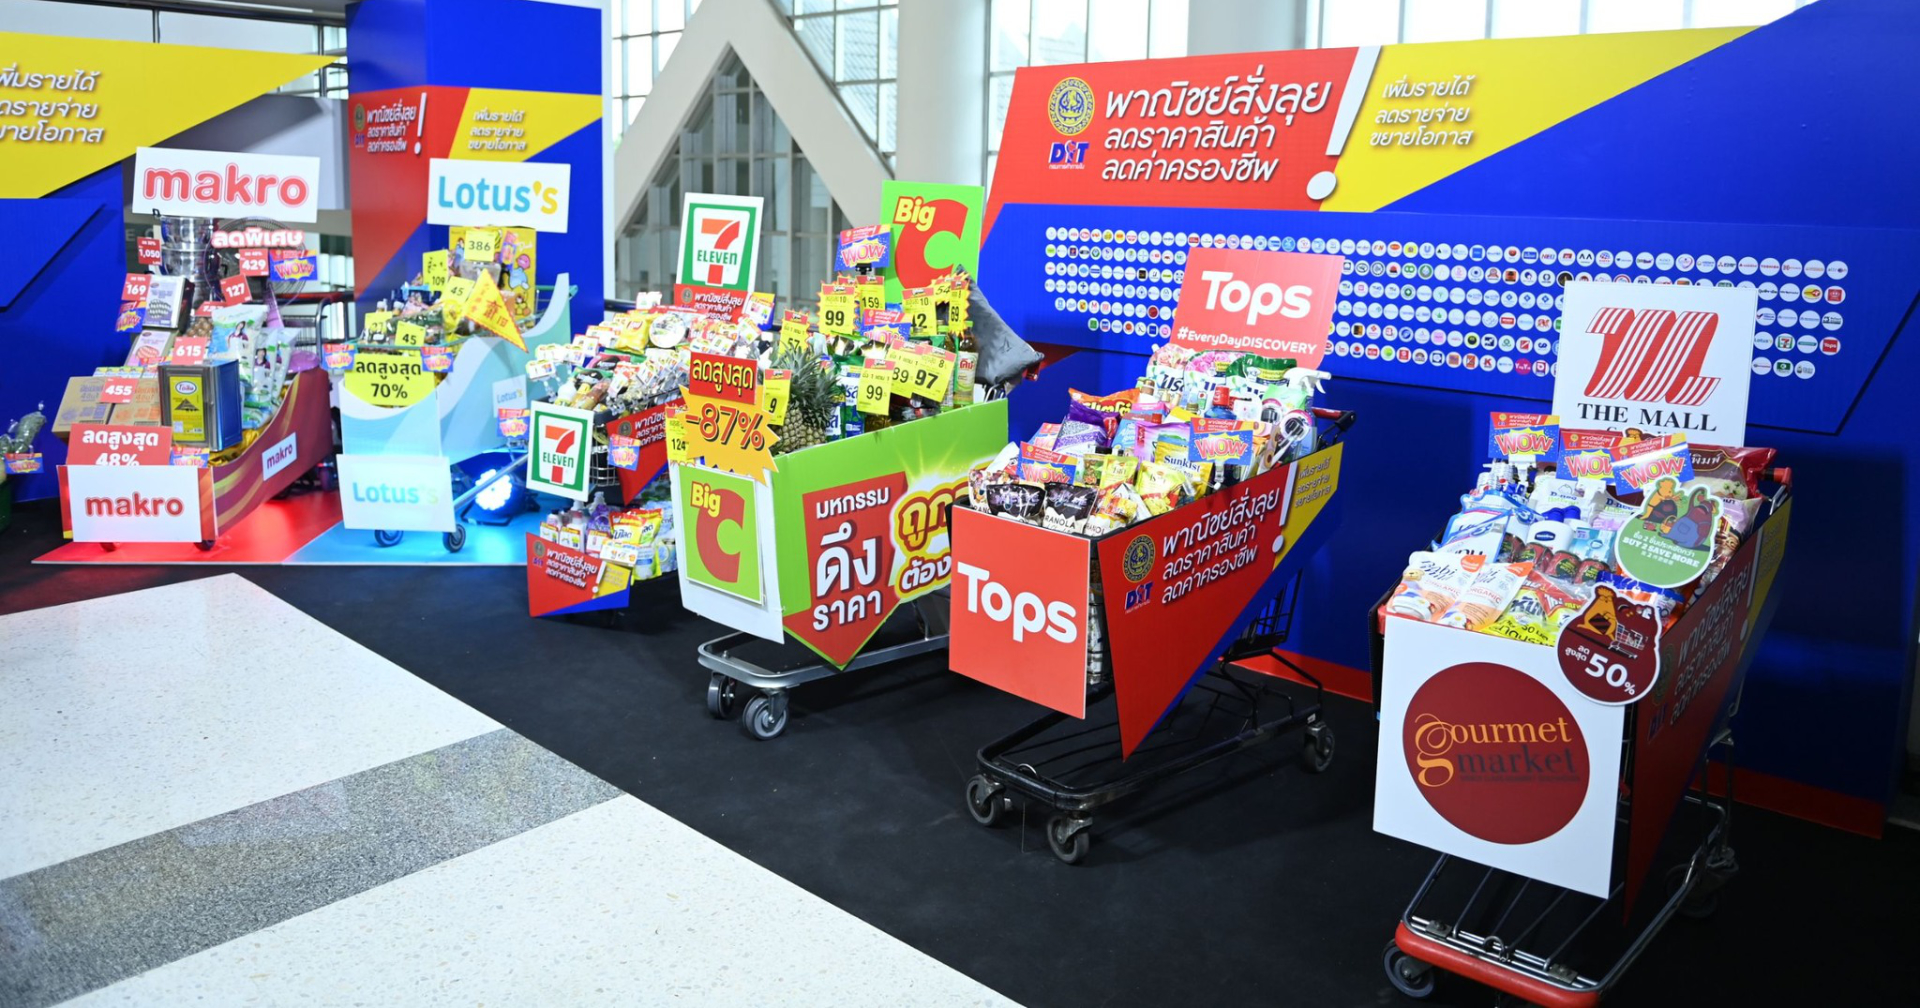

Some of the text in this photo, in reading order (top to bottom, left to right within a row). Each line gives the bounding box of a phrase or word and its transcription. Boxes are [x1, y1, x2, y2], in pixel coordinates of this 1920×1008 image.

[1106, 64, 1331, 126] พาณิชย์สั่งลุย
[1382, 73, 1477, 98] เพิ่มรายได้
[473, 107, 525, 123] เพิ่มรายได้
[1374, 103, 1470, 125] ลดรายจ่าย
[469, 124, 523, 138] ลดรายจ่าย
[1104, 115, 1275, 150] ลดราคาสินค้า
[1369, 126, 1474, 148] ขยายโอกาส
[467, 137, 527, 151] ขยายโอกาส
[1101, 151, 1279, 182] ลดค่าครองชีพ
[143, 163, 309, 207] makro
[438, 175, 558, 214] Lotus's
[894, 196, 936, 231] Big
[211, 226, 305, 249] ลดพิเศษ
[468, 240, 491, 251] 386
[701, 218, 740, 284] 7
[242, 260, 266, 271] 429
[126, 284, 147, 295] 169
[226, 284, 245, 297] 127
[432, 275, 445, 286] 109
[862, 296, 880, 308] 159
[1201, 270, 1312, 326] Tops
[825, 310, 845, 326] 99
[176, 345, 202, 357] 615
[402, 333, 417, 345] 45
[1177, 326, 1318, 356] #EveryDayDISCOVERY
[356, 361, 421, 380] ลดสูงสุด
[692, 358, 754, 396] ลดสูงสุด
[915, 369, 938, 389] 97
[105, 385, 132, 396] 455
[371, 383, 408, 398] 70%
[866, 385, 883, 401] 99
[769, 397, 778, 413] 9
[1577, 402, 1717, 433] THE MALL
[685, 402, 765, 450] -87%
[82, 430, 159, 451] ลดสูงสุด
[1194, 439, 1248, 459] WOW
[1494, 433, 1554, 455] WOW
[266, 442, 293, 469] makro
[545, 425, 575, 483] 7
[1164, 453, 1200, 472] Sunkist
[1621, 457, 1686, 489] WOW
[85, 491, 184, 517] makro
[690, 480, 720, 518] Big
[816, 487, 889, 520] มหกรรม
[1162, 486, 1280, 557] พาณิชย์สั่งลุย
[816, 521, 877, 598] ดึง
[1163, 519, 1256, 581] ลดราคาสินค้า
[1622, 537, 1642, 548] BUY
[1648, 545, 1672, 558] SAVE
[1671, 553, 1700, 568] MORE
[1161, 544, 1258, 605] ลดค่าครองชีพ
[812, 589, 882, 632] ราคา
[957, 561, 1077, 645] Tops
[1565, 647, 1590, 662] สูงสุด
[1578, 645, 1590, 655] ลด
[1415, 713, 1572, 788] gourmet
[1458, 744, 1577, 774] market
